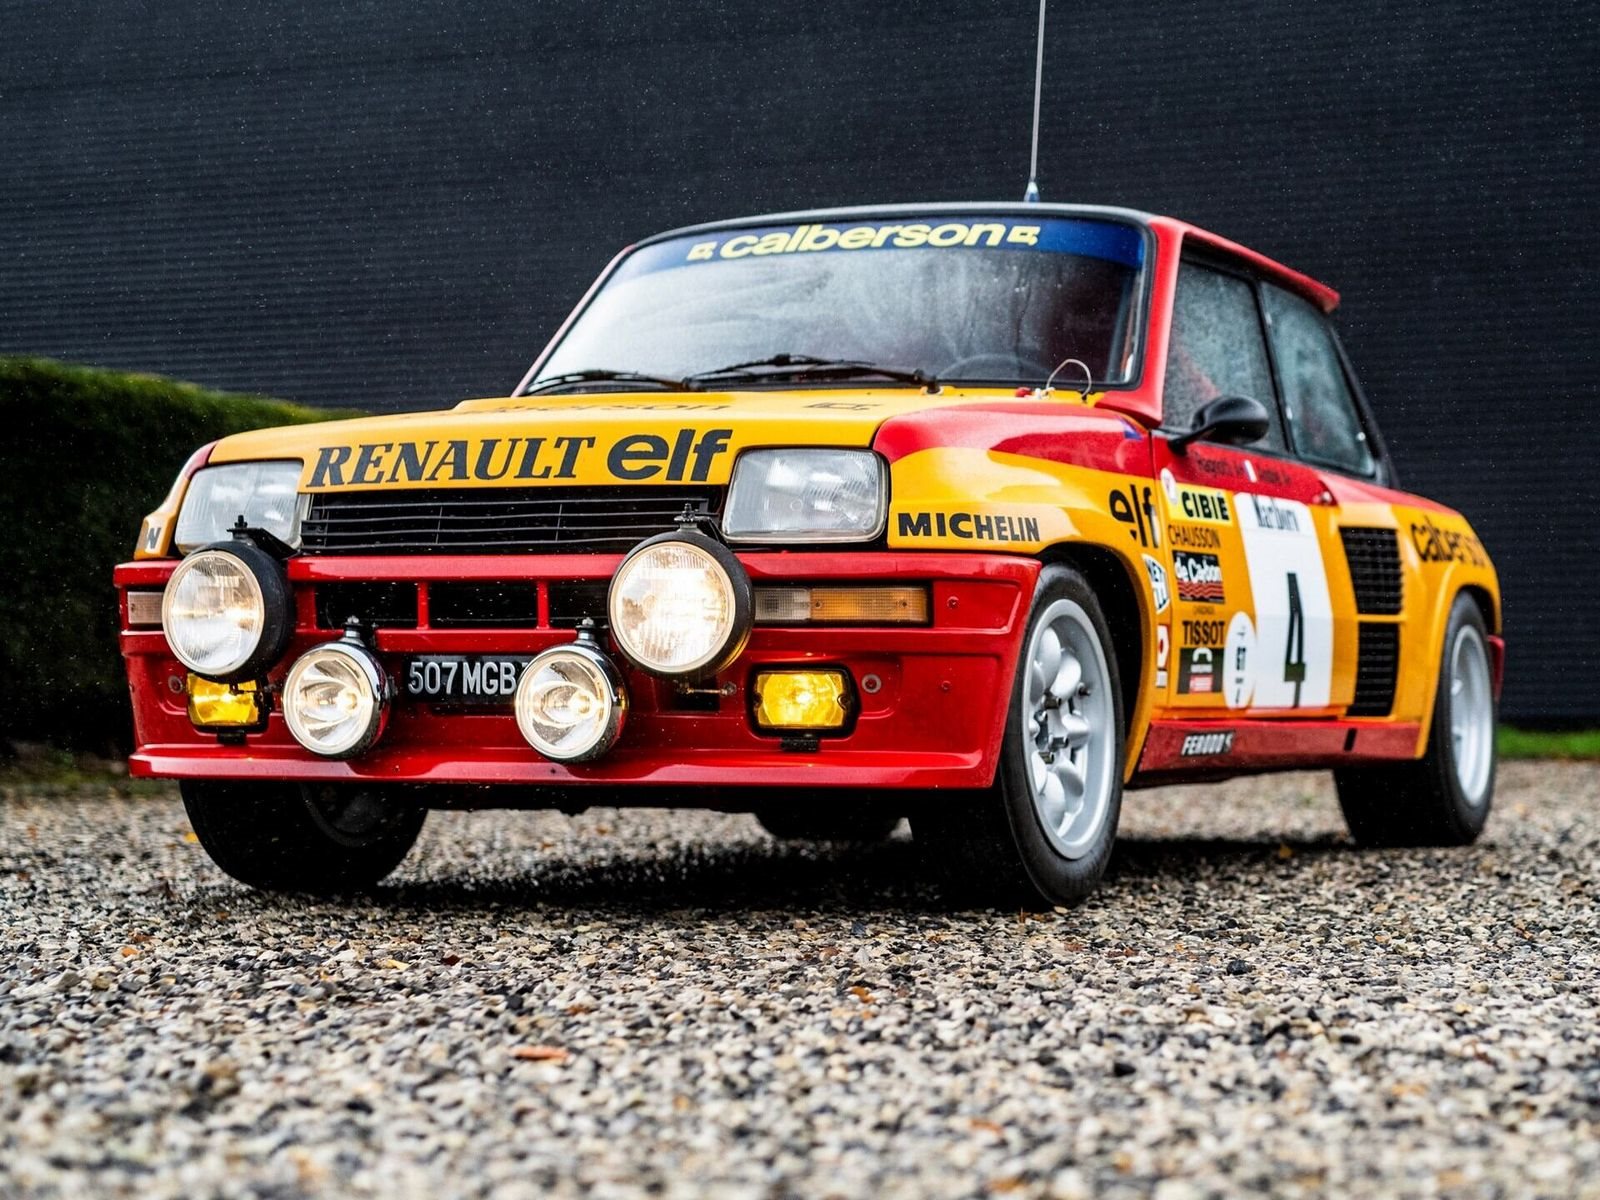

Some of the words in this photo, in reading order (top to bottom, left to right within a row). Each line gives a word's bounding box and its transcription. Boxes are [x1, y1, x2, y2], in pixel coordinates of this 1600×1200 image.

[719, 222, 1008, 259] calberson
[305, 436, 595, 488] RENAULT
[606, 428, 733, 482] elf
[898, 512, 1041, 542] MICHELIN
[1108, 483, 1159, 549] elf
[1168, 524, 1222, 548] CHAUSSON
[1182, 620, 1225, 646] TISSOT
[1282, 572, 1307, 707] 4
[407, 661, 458, 695] 507
